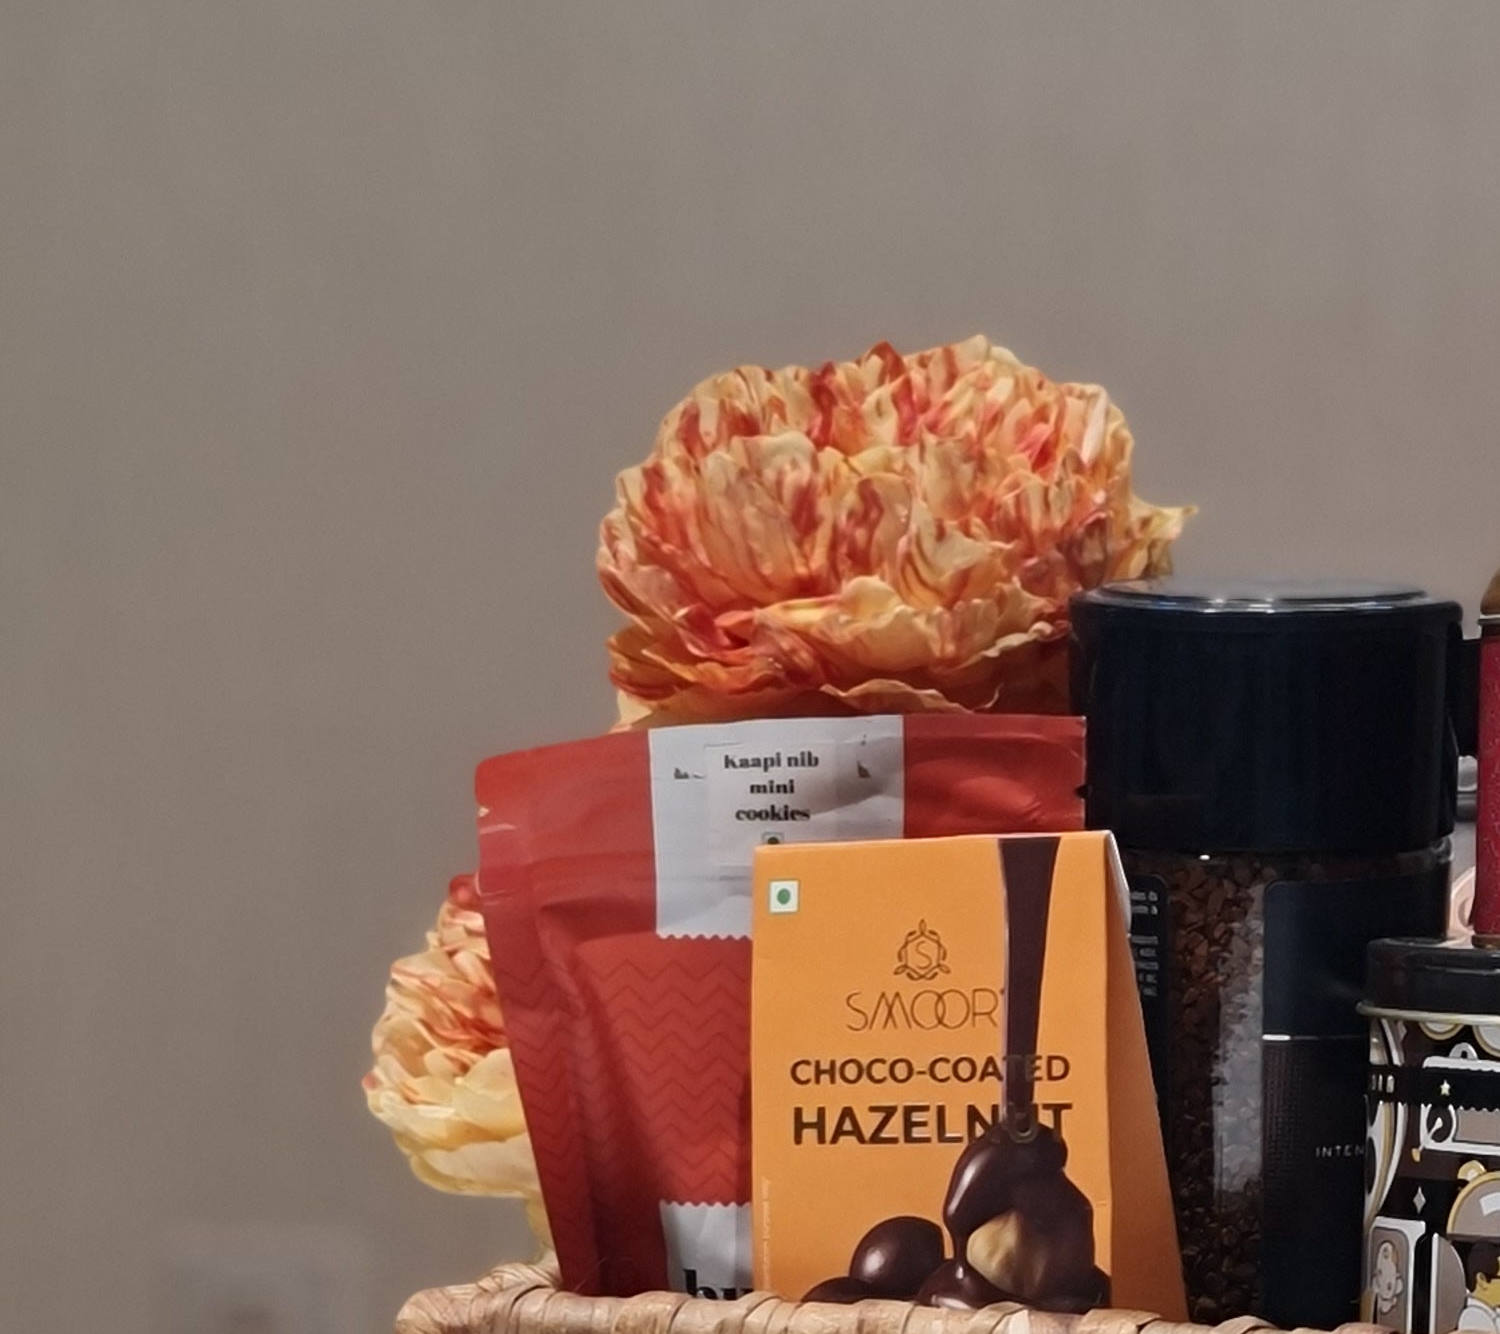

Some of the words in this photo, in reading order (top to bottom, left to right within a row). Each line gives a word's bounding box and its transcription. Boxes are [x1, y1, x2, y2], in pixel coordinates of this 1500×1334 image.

[724, 752, 781, 772] Kaapi
[787, 751, 819, 767] nib
[750, 779, 795, 794] mini
[735, 804, 811, 822] cookies
[846, 988, 999, 1031] SMOOR
[790, 1054, 1071, 1085] CHOCO-COAED
